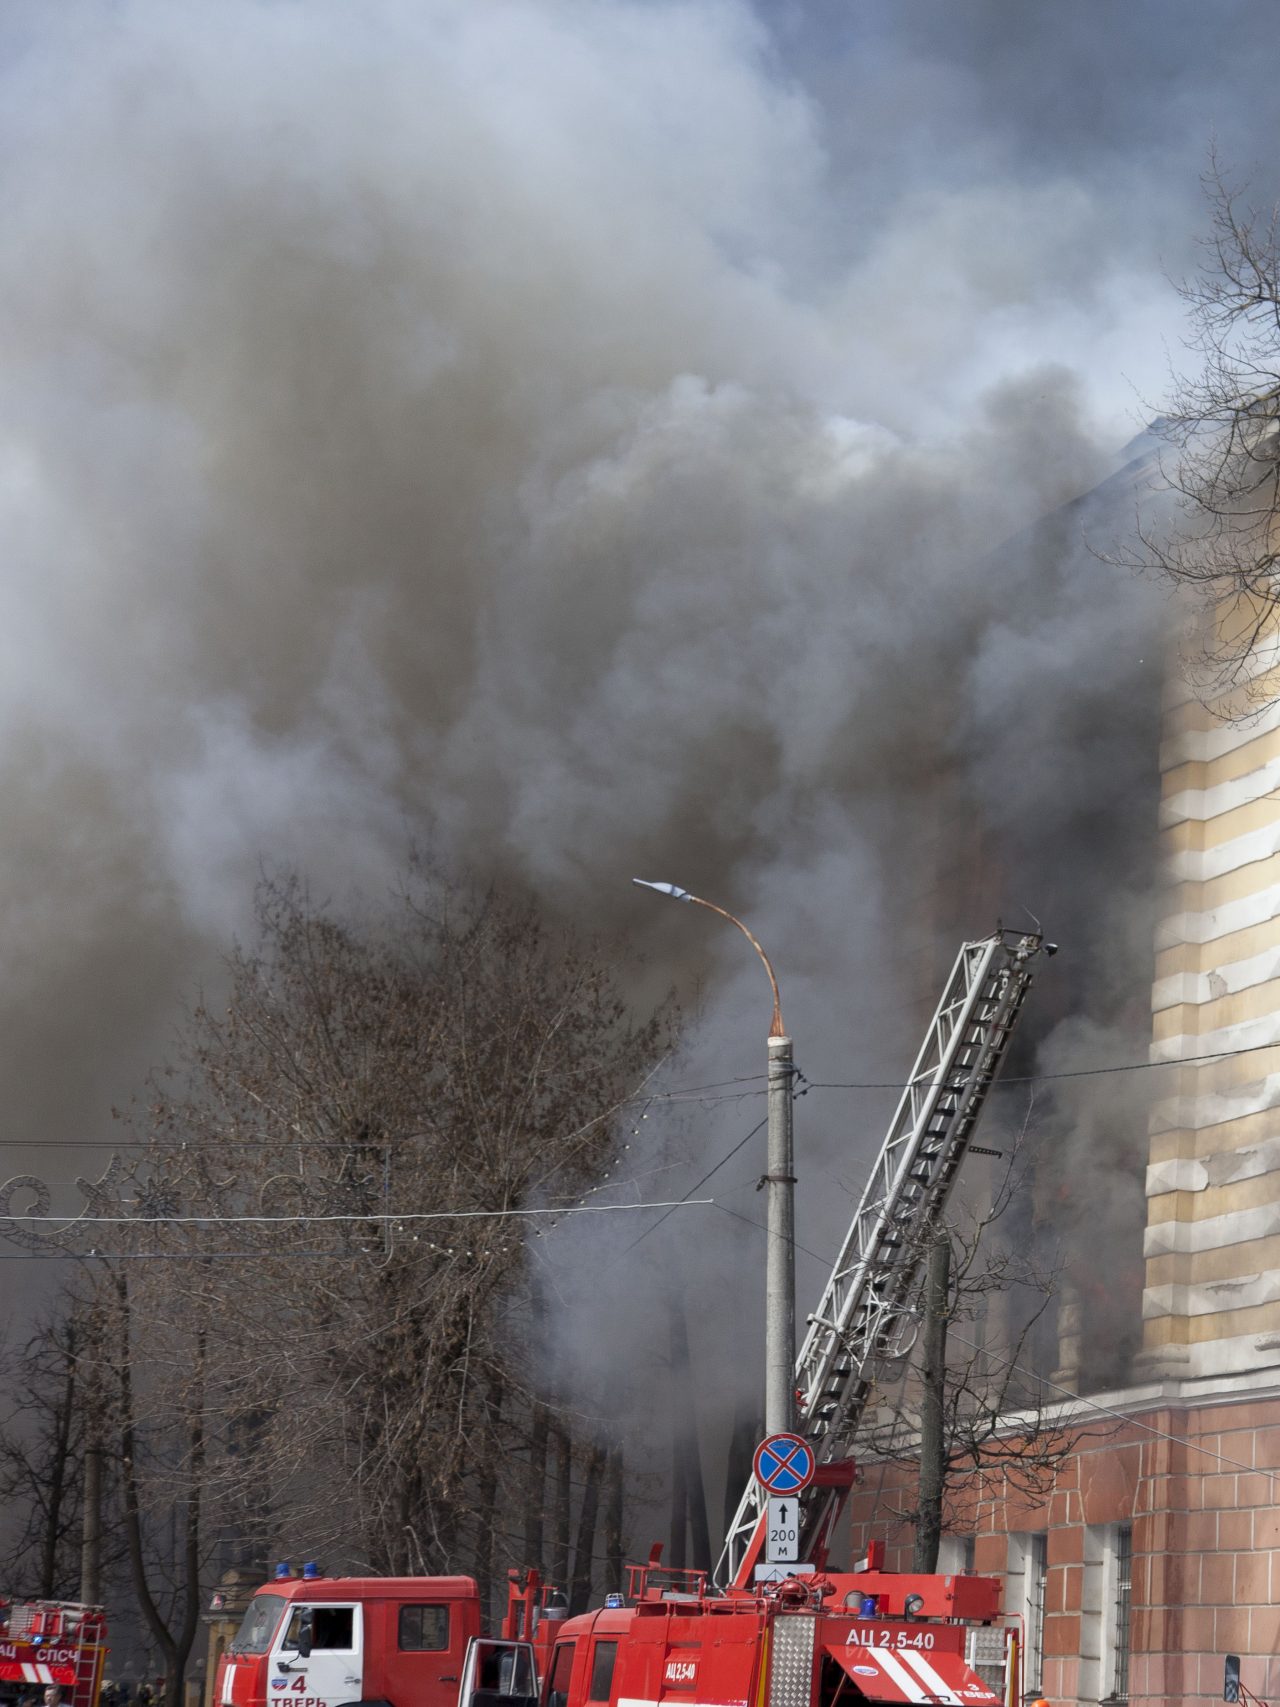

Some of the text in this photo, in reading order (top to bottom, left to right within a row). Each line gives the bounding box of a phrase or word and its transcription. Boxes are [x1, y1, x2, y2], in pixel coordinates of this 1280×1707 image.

[770, 1529, 796, 1542] 200
[845, 1628, 935, 1650] АЦ 2,5-40
[36, 1648, 81, 1663] СПСЧ
[666, 1663, 676, 1682] АЦ
[290, 1675, 307, 1694] 4
